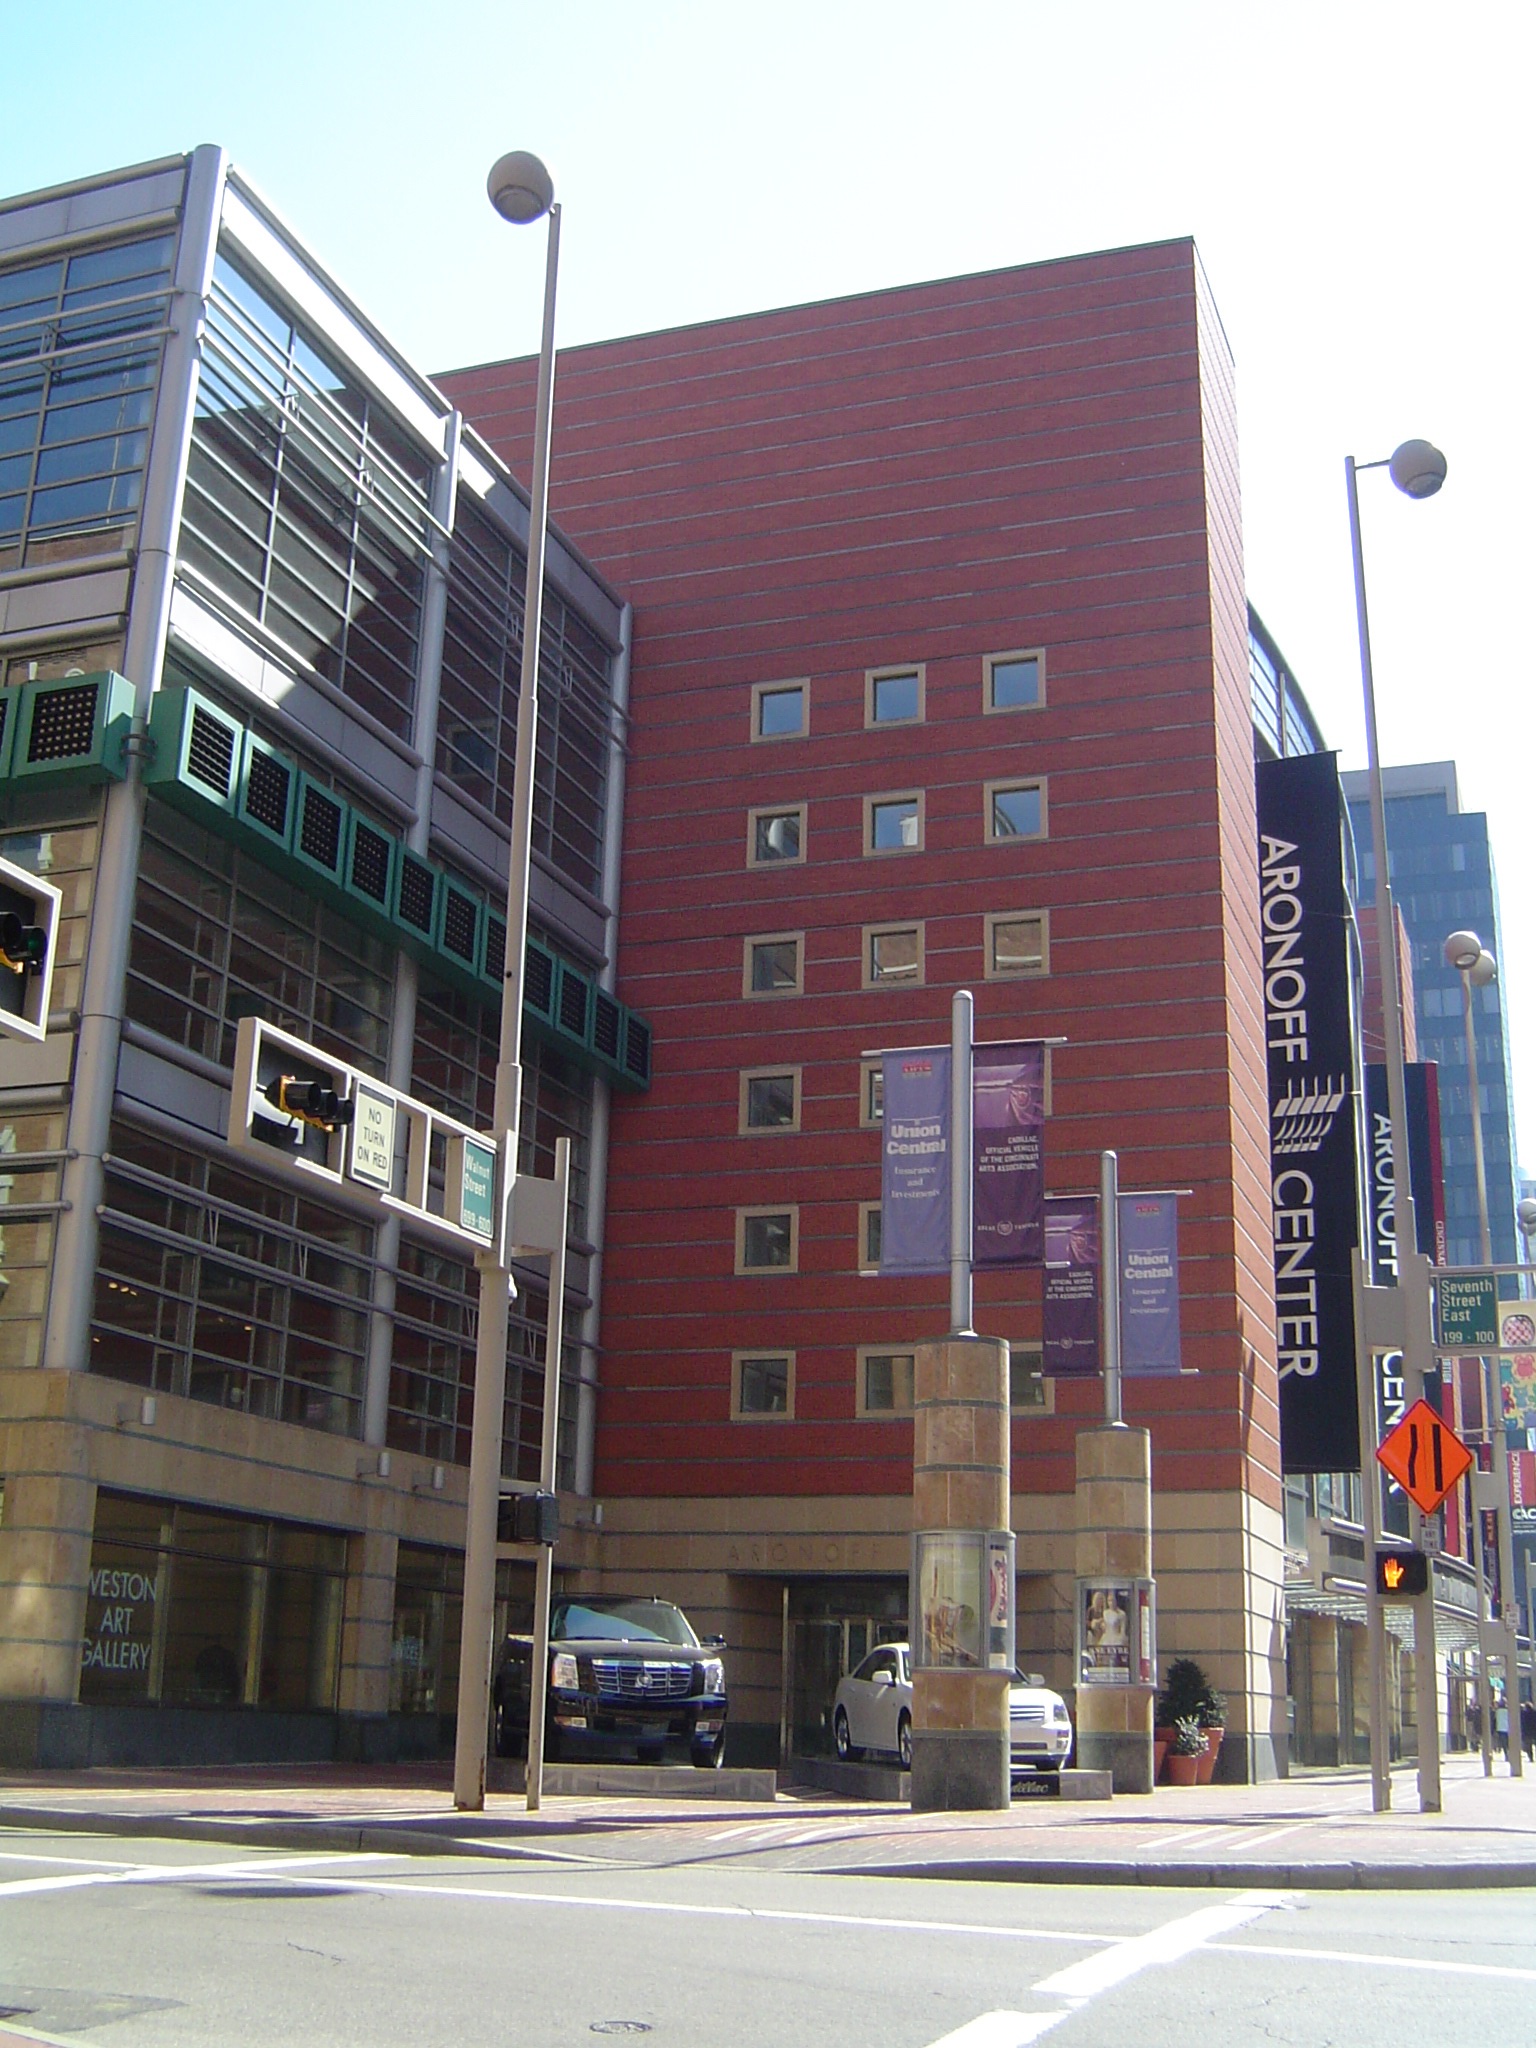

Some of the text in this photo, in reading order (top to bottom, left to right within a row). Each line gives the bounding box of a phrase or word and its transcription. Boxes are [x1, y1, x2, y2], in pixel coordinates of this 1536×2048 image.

[1261, 834, 1308, 1063] ARONOFF
[368, 1107, 382, 1125] NO
[363, 1126, 385, 1148] TURN
[890, 1124, 941, 1139] Union
[886, 1138, 946, 1155] Central
[357, 1146, 388, 1170] ON RED
[465, 1154, 490, 1180] Walnut
[894, 1166, 936, 1175] Insurance
[464, 1173, 487, 1198] Street
[907, 1178, 923, 1186] and
[891, 1189, 939, 1199] Investments
[1128, 1254, 1168, 1265] Union
[1124, 1266, 1173, 1279] Central
[1272, 1169, 1319, 1380] CENTER
[1441, 1279, 1493, 1294] Seventh
[1441, 1294, 1482, 1308] Street
[1442, 1308, 1471, 1322] East
[1443, 1331, 1463, 1343] 199
[1475, 1330, 1495, 1343] 100
[726, 1541, 880, 1563] ARONOFF
[100, 1606, 134, 1635] ART
[81, 1637, 151, 1670] GALLERY
